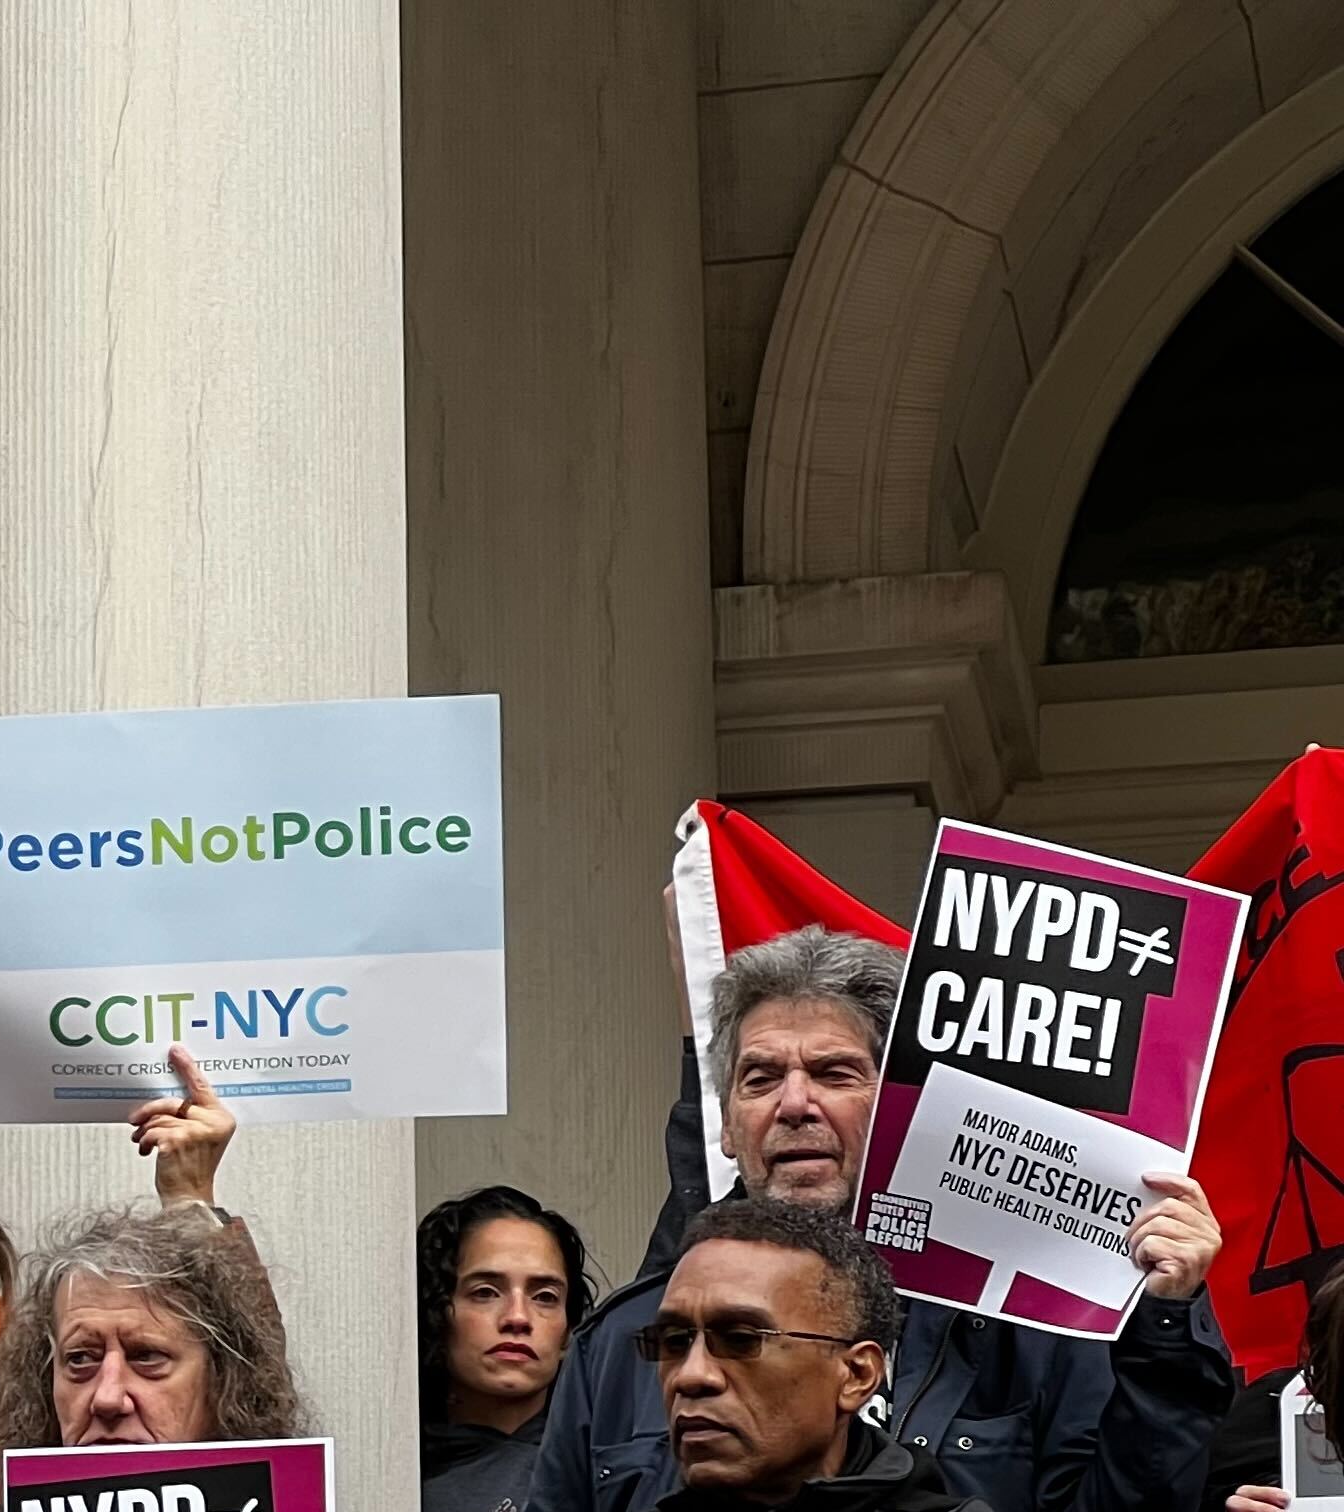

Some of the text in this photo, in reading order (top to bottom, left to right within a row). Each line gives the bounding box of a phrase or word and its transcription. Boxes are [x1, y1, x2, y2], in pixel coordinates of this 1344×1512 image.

[49, 986, 349, 1047] CCIT-NYC
[917, 970, 1122, 1077] CARE!
[52, 1054, 350, 1076] CORRECT CRISIS TODAY
[963, 1108, 1078, 1167] MAYOR ADAMS,
[939, 1171, 992, 1203] PUBLIC
[993, 1191, 1053, 1226] HEALTH
[949, 1134, 1142, 1226] NYC DESERVES
[865, 1228, 924, 1252] REFORM
[867, 1213, 927, 1238] POLICE
